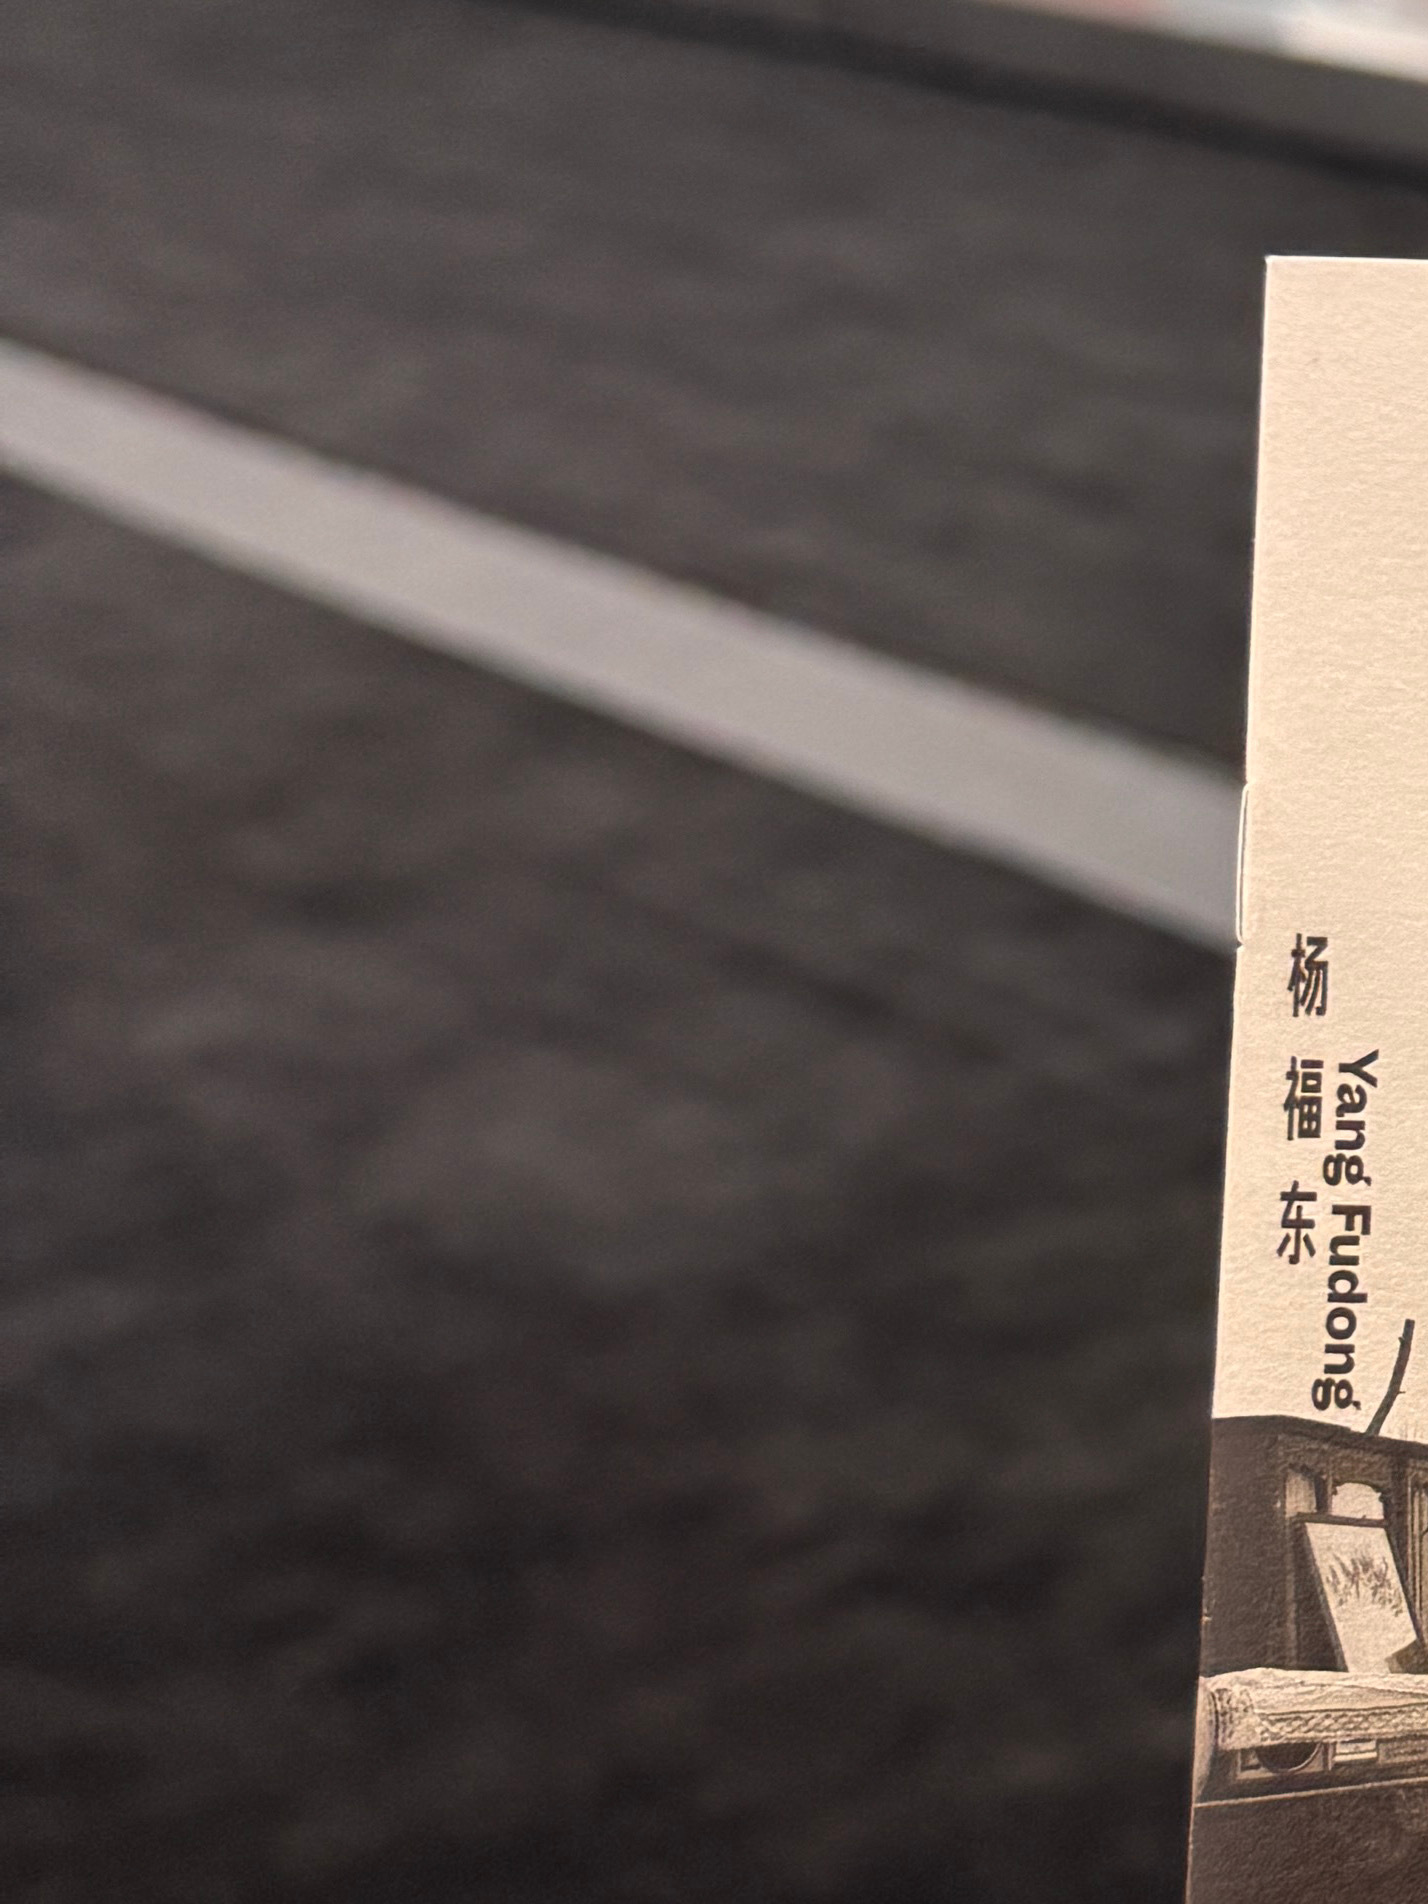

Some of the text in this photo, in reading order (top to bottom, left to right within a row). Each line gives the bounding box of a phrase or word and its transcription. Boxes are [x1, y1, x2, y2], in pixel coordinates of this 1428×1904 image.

[1276, 932, 1329, 1266] 杨福东
[1311, 1049, 1380, 1412] Yang Fudong
